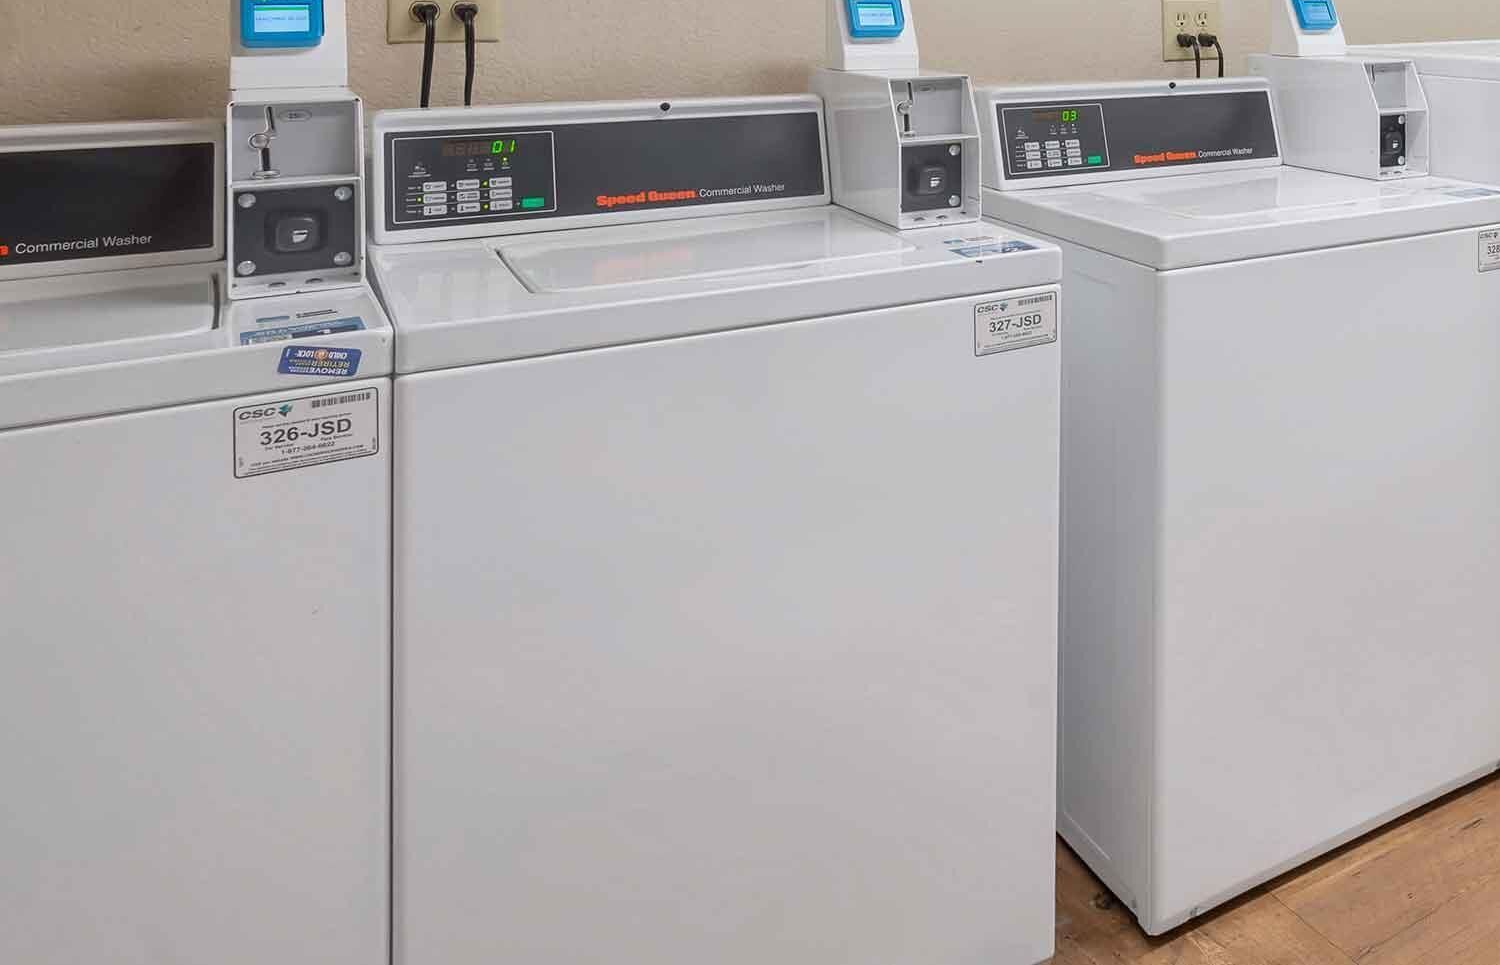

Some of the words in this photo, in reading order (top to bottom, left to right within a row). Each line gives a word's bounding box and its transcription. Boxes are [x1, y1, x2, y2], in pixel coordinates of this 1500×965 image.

[1062, 110, 1077, 121] 03
[491, 139, 515, 154] 01
[1198, 149, 1232, 158] Commercial
[1232, 147, 1253, 155] Washer
[596, 190, 646, 207] Speed
[648, 189, 696, 203] Queen
[699, 185, 751, 198] Commercial
[752, 183, 785, 193] Washer
[15, 238, 99, 254] Commercial
[102, 234, 152, 247] Washer
[989, 314, 1042, 333] 327-JSD
[238, 407, 276, 421] CSC
[260, 418, 352, 446] 326-JSD
